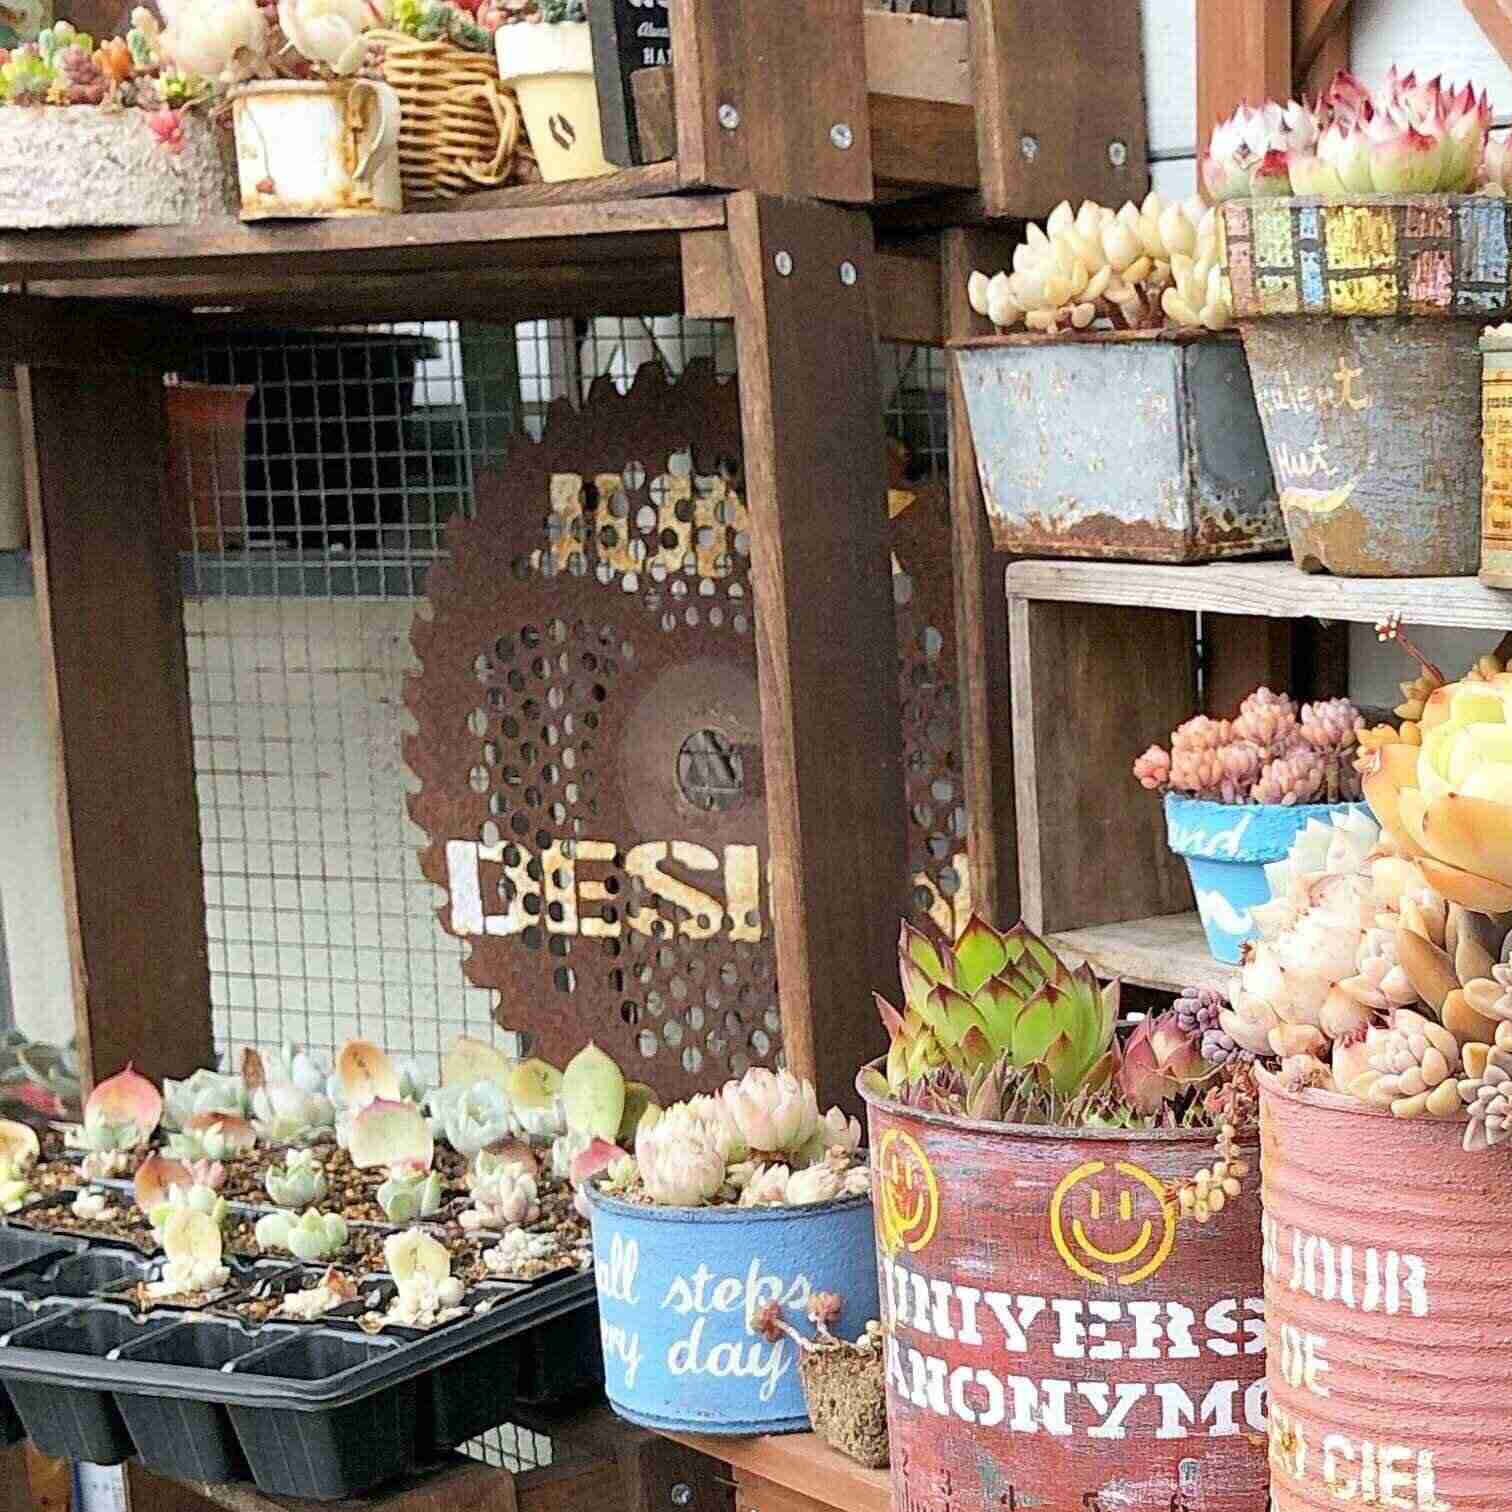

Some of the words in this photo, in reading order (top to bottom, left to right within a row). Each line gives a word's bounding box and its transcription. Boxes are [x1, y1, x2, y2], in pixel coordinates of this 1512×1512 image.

[446, 840, 775, 942] DESI
[659, 1257, 812, 1336] steps
[1289, 1228, 1429, 1318] JOUR
[668, 1315, 792, 1400] day
[1280, 1323, 1330, 1398] DE
[1002, 1485, 1015, 1512] 4
[1322, 1435, 1451, 1512] CIEL
